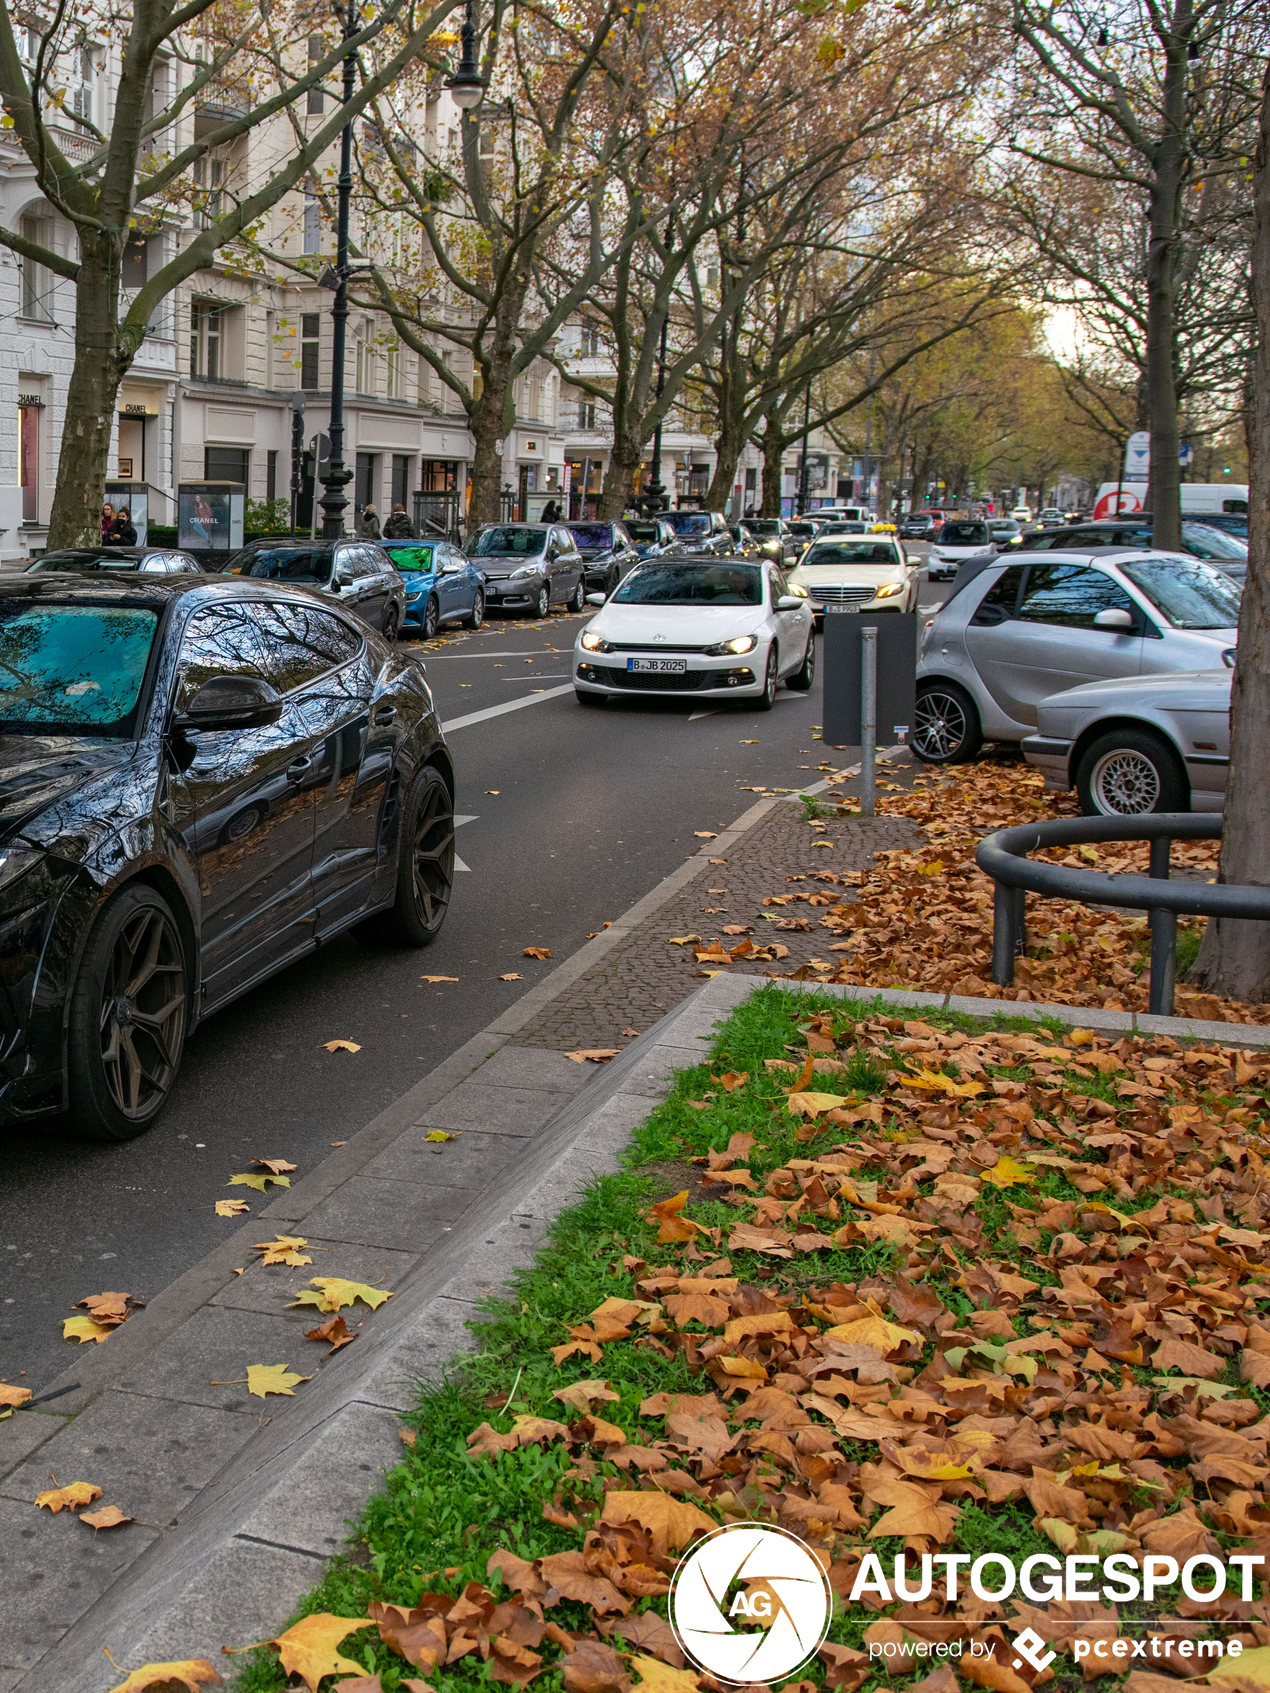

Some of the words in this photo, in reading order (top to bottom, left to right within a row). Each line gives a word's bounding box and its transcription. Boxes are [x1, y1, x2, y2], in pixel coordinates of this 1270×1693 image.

[125, 404, 146, 413] CHANEL
[633, 660, 640, 670] B
[645, 661, 658, 671] JB
[660, 661, 685, 671] 2025
